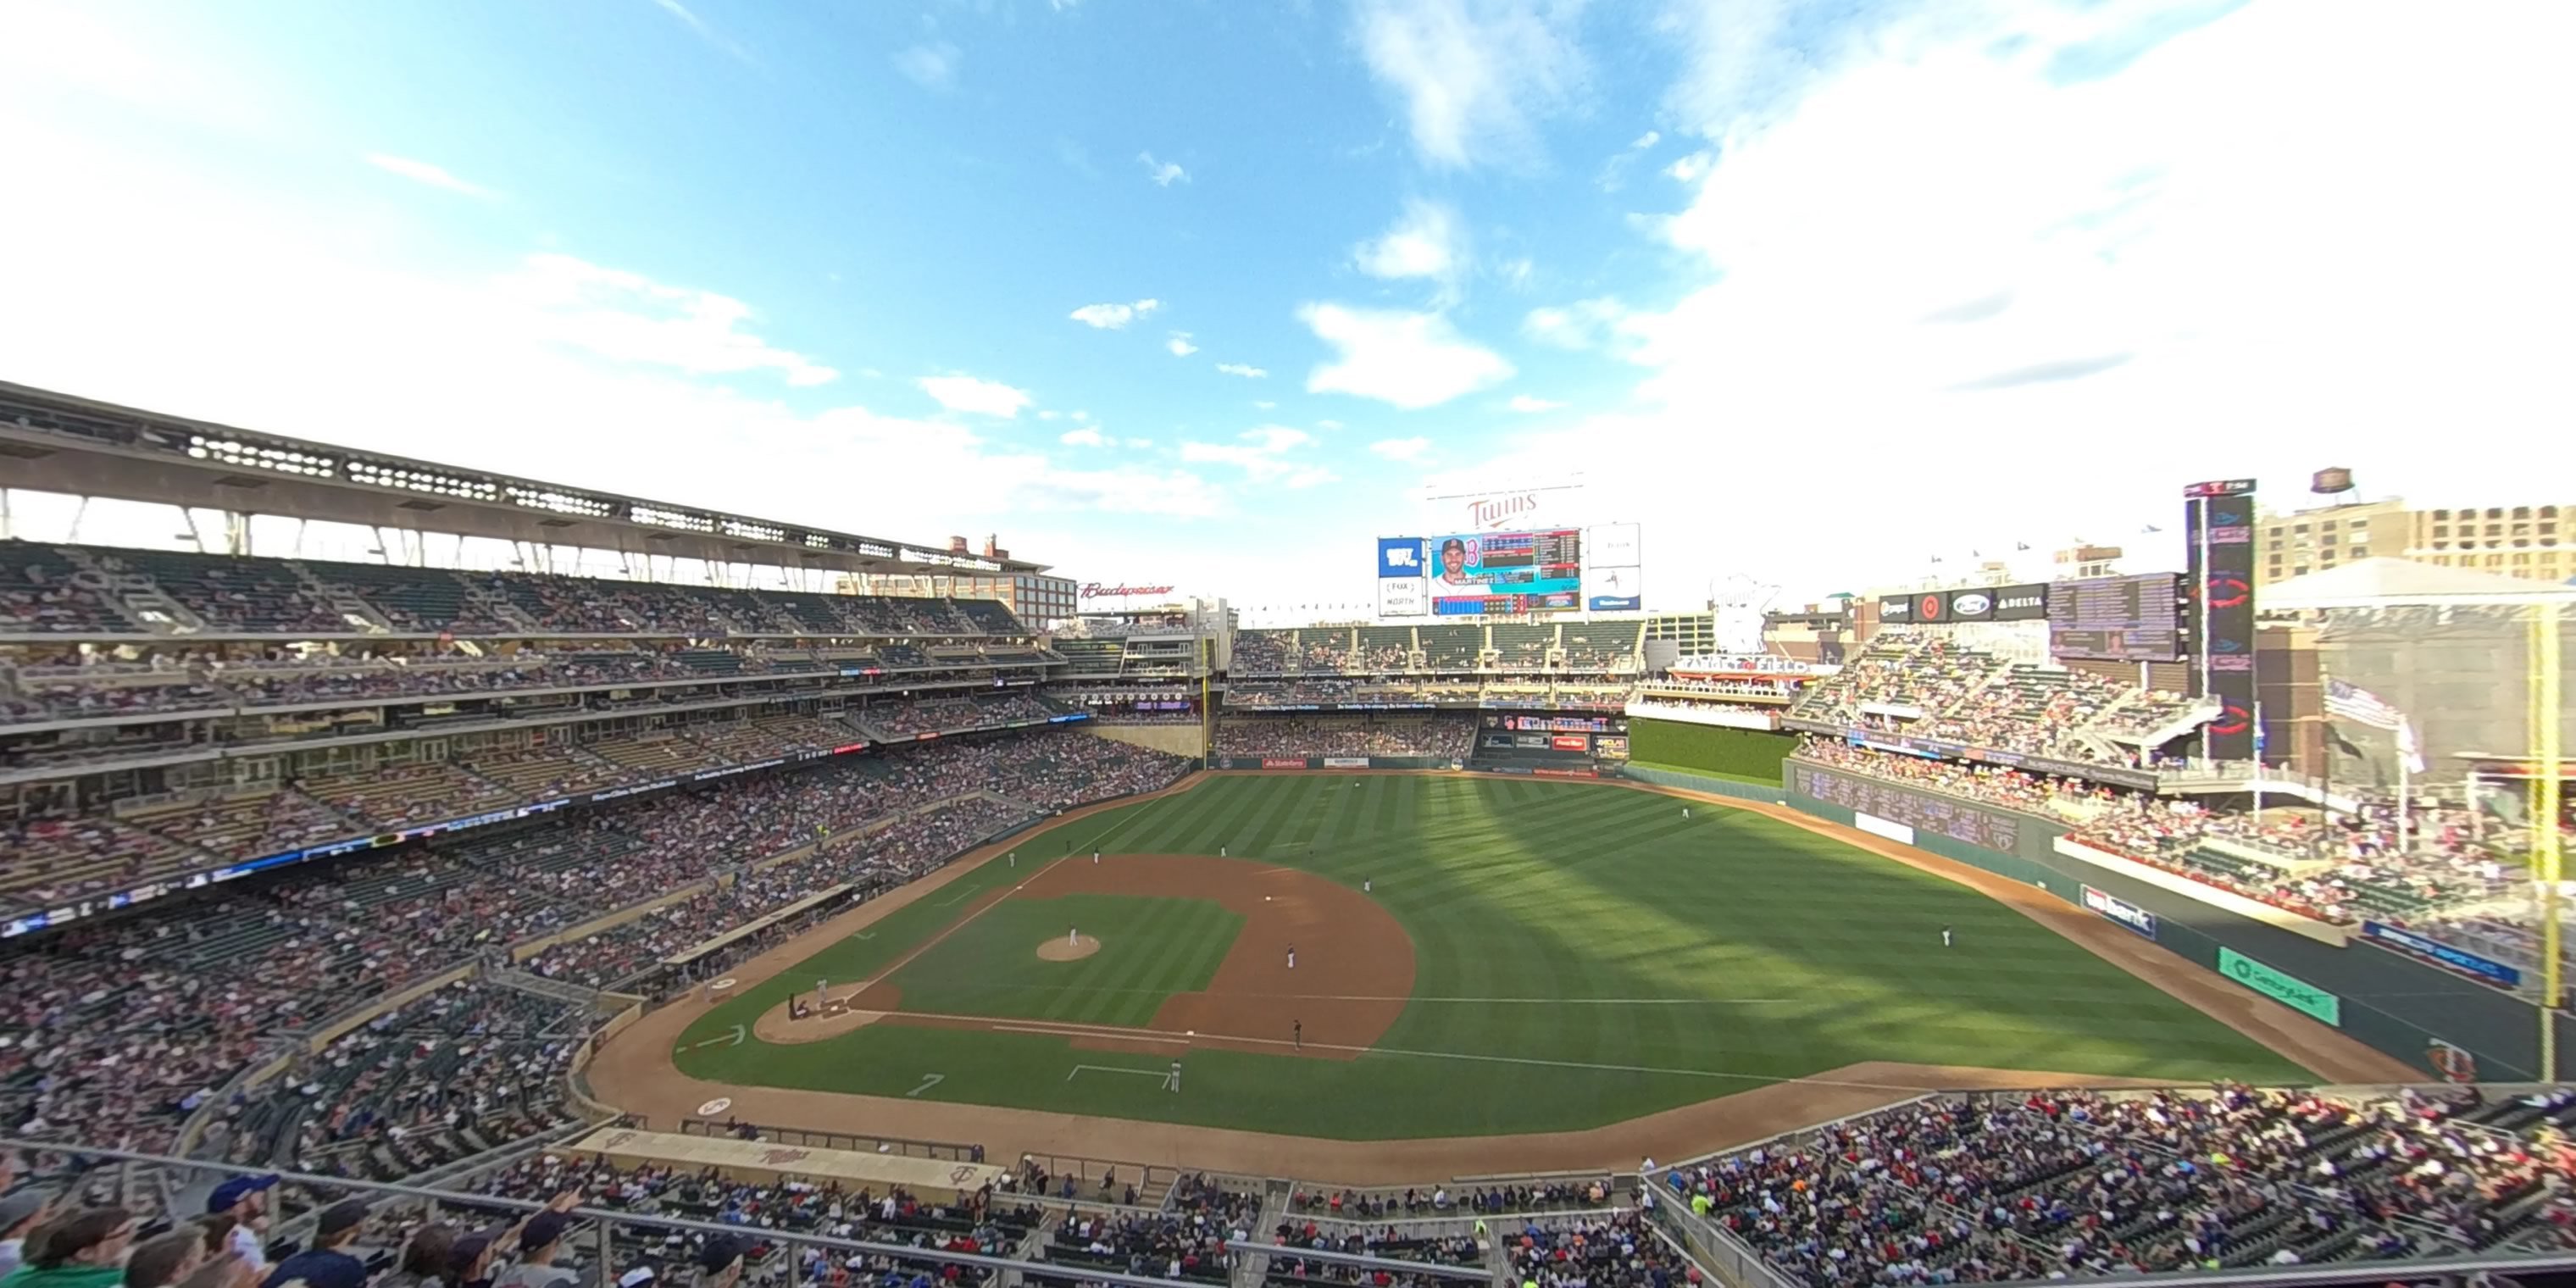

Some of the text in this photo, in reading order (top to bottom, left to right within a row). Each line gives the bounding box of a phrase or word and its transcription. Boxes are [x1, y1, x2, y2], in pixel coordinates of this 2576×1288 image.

[1468, 493, 1537, 529] Twins
[1076, 581, 1175, 599] Budweiser
[2007, 597, 2043, 608] DELTA
[1757, 659, 1809, 674] FIELD
[906, 1073, 946, 1096] 7
